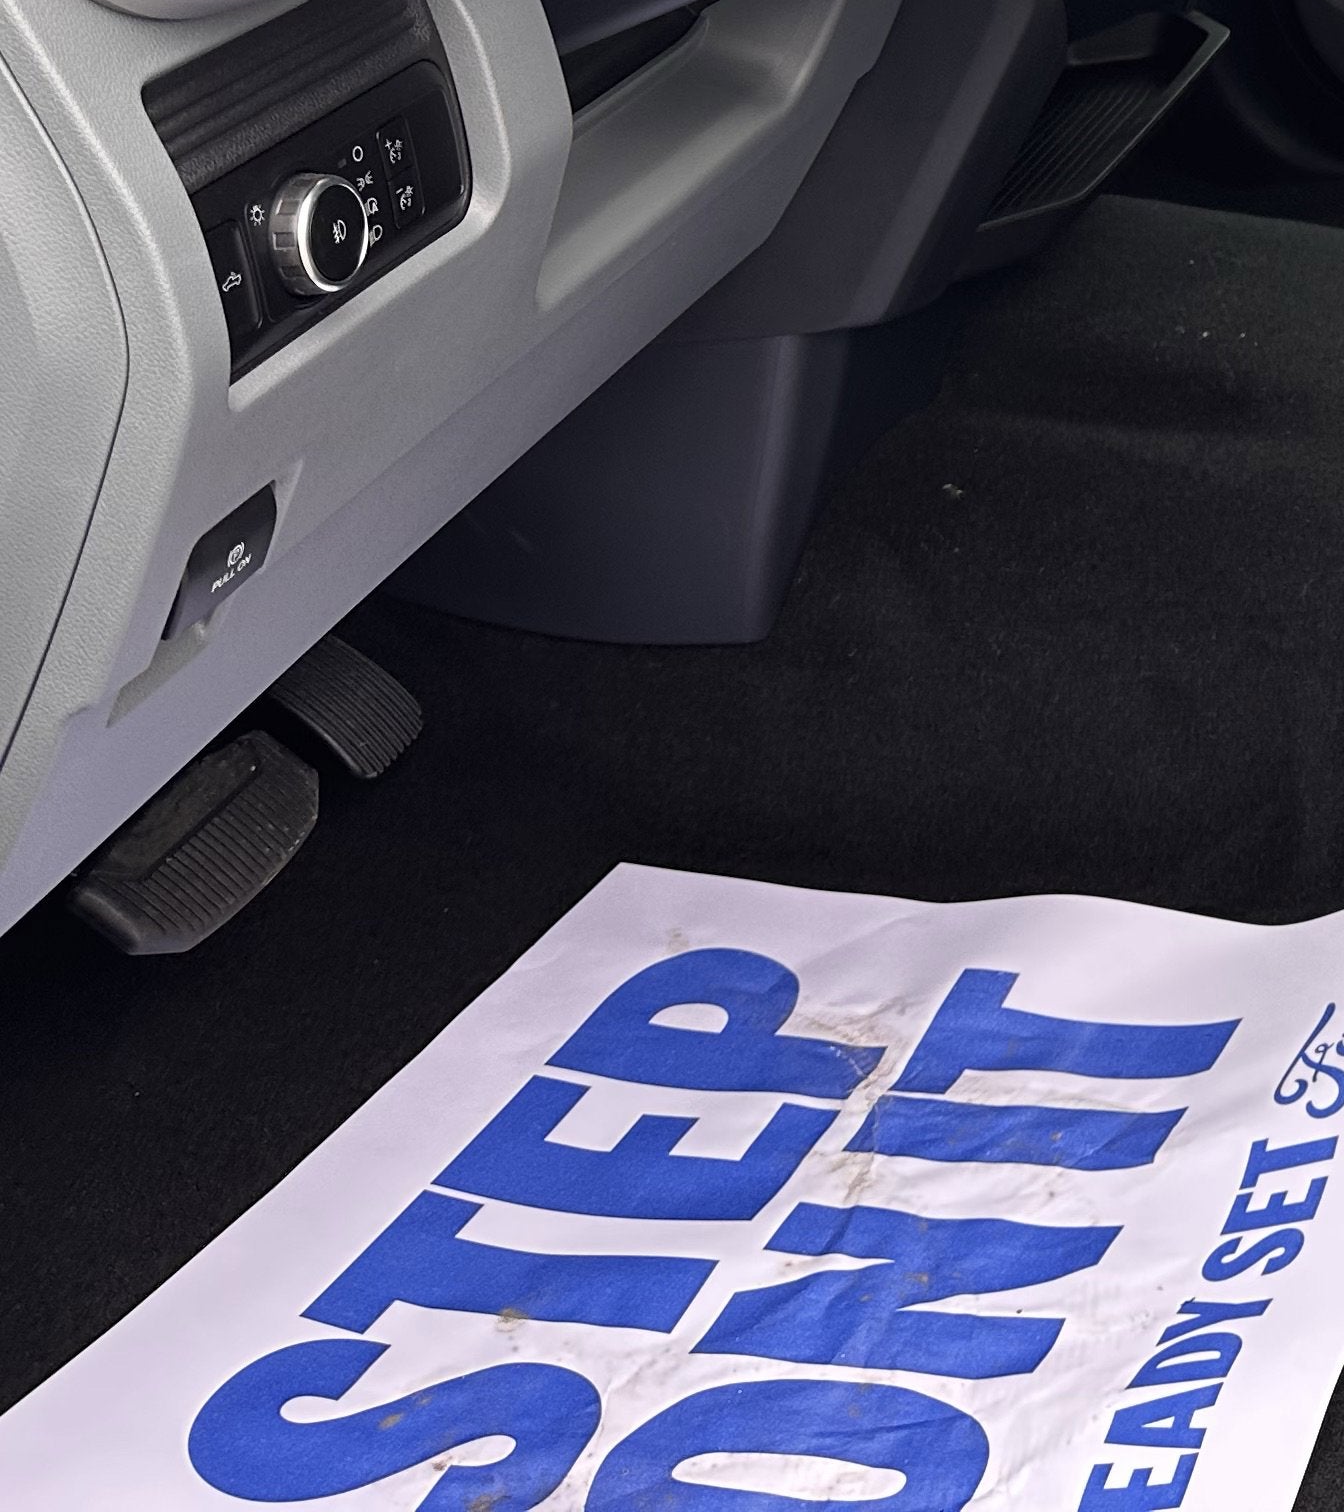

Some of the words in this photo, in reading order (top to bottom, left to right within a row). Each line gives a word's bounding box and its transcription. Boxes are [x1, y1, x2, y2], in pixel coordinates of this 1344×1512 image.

[841, 968, 1242, 1170] IT
[188, 947, 886, 1512] STEP
[1202, 1135, 1338, 1282] SET
[584, 1201, 1123, 1512] ON
